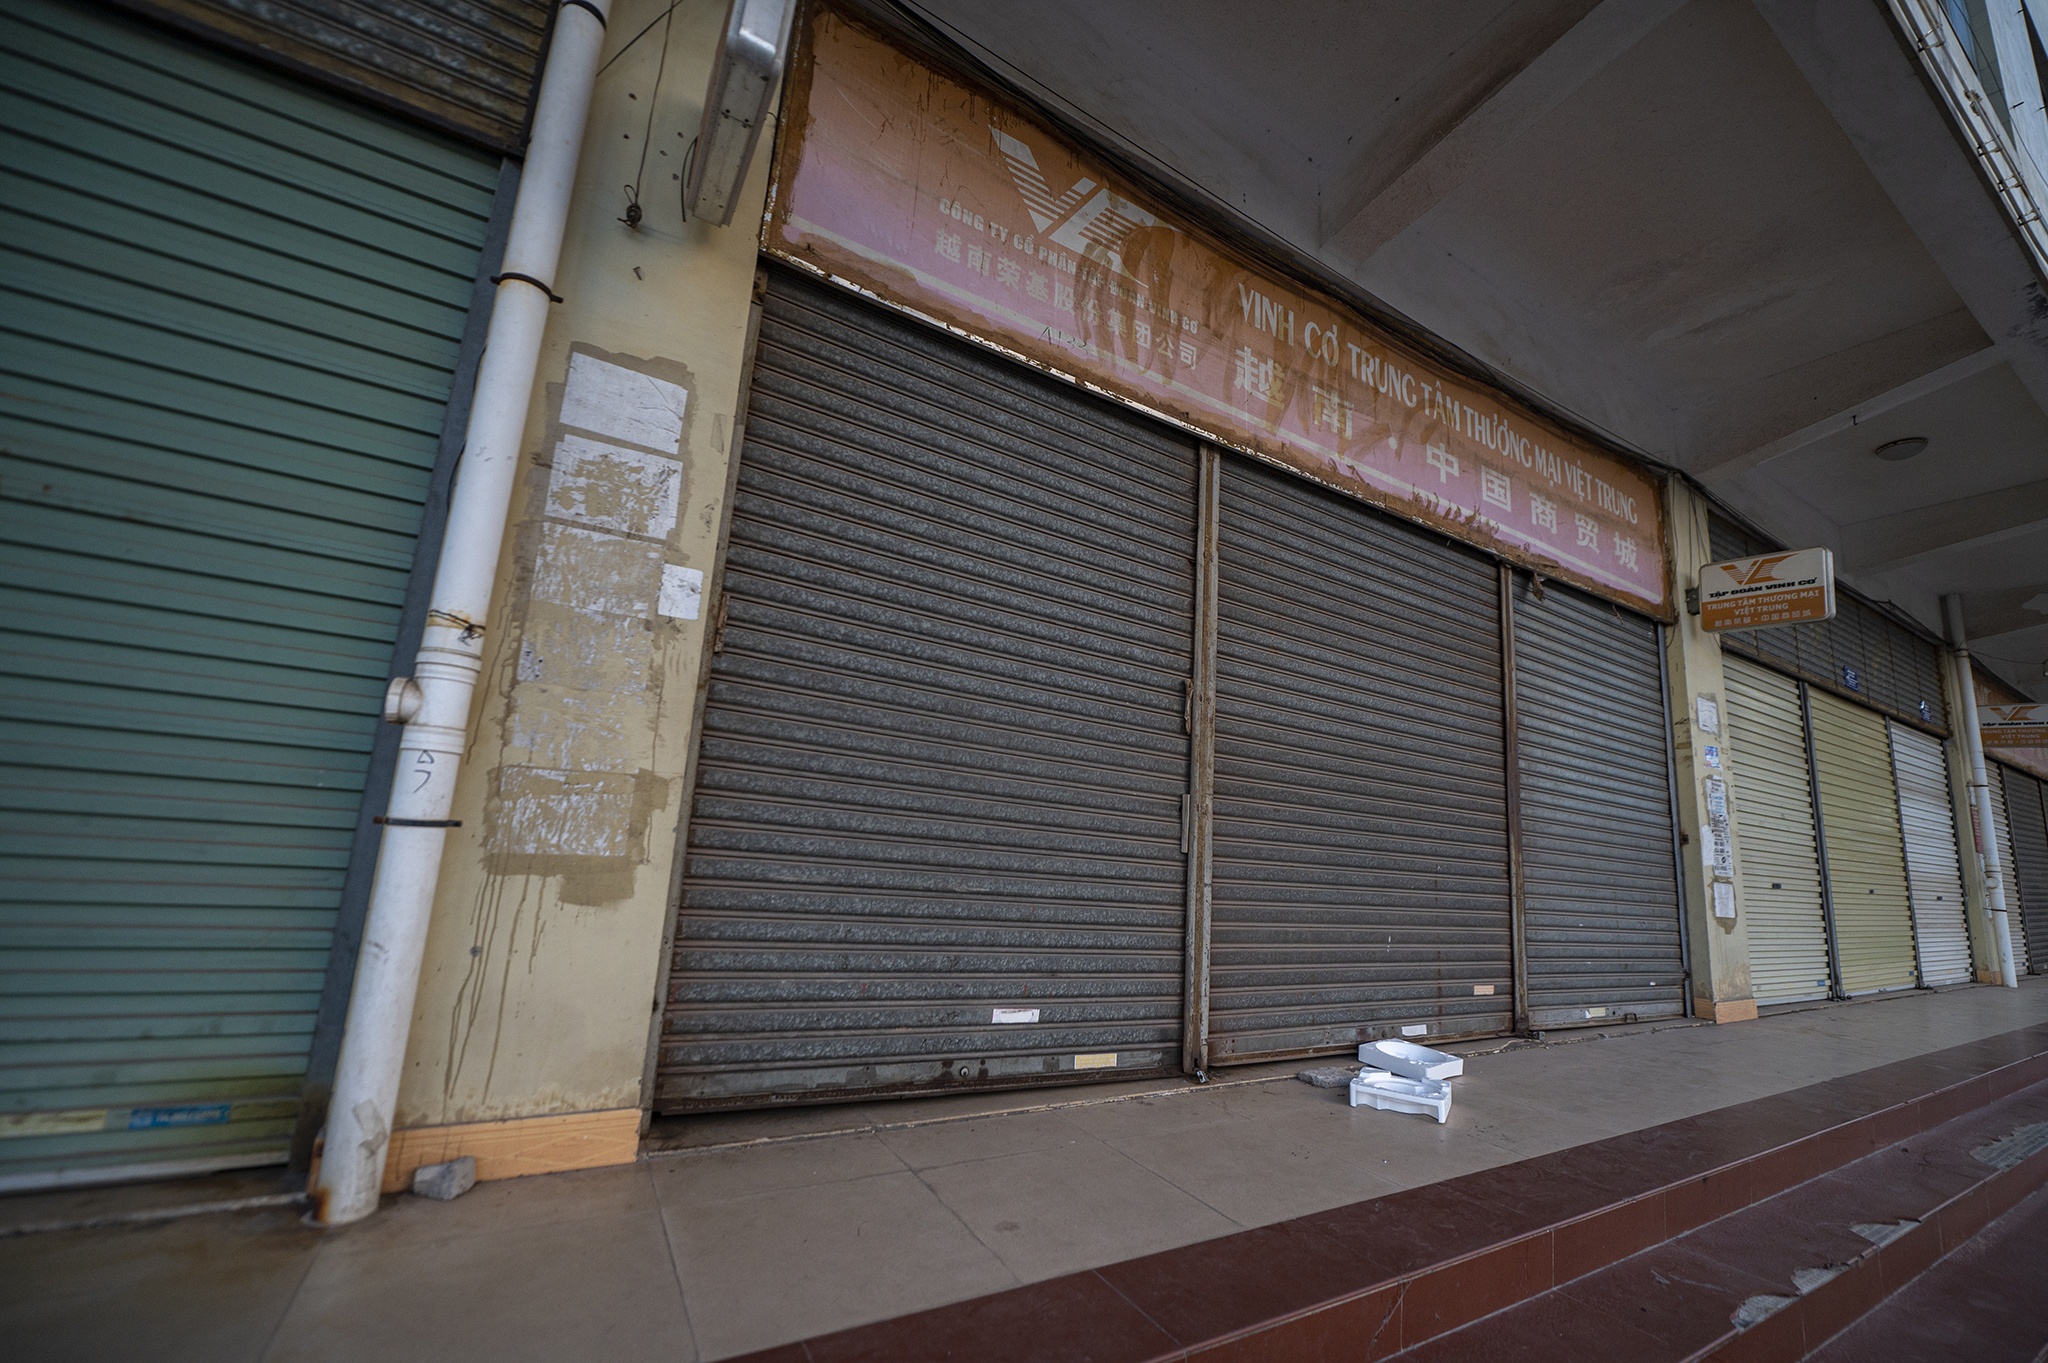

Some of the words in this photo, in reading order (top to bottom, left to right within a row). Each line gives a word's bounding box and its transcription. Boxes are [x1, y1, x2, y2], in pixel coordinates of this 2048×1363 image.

[939, 198, 985, 232] CÔNG
[988, 221, 1009, 242] TY
[1013, 234, 1035, 255] CỔ
[1181, 315, 1199, 335] CƠ
[1238, 282, 1295, 347] VINH
[1303, 321, 1340, 368] CƠ
[1347, 341, 1418, 409] TRUNG
[1420, 380, 1461, 432] TÂM
[1462, 404, 1533, 469] THƯƠNG
[1534, 443, 1562, 488] MẠI
[1564, 459, 1593, 504] VIỆT
[1595, 477, 1639, 525] TRUNG
[1706, 601, 1736, 611] TRUNG
[1738, 596, 1756, 606] TÂM
[1758, 591, 1798, 604] THƯƠNG
[1800, 589, 1820, 599] MẠI
[1708, 590, 1730, 600] TẬP
[1731, 584, 1762, 595] ĐOÀN
[1765, 580, 1796, 590] VINH
[1798, 576, 1818, 586] CƠ
[1734, 605, 1755, 616] VIỆT
[1757, 602, 1789, 613] TRUNG
